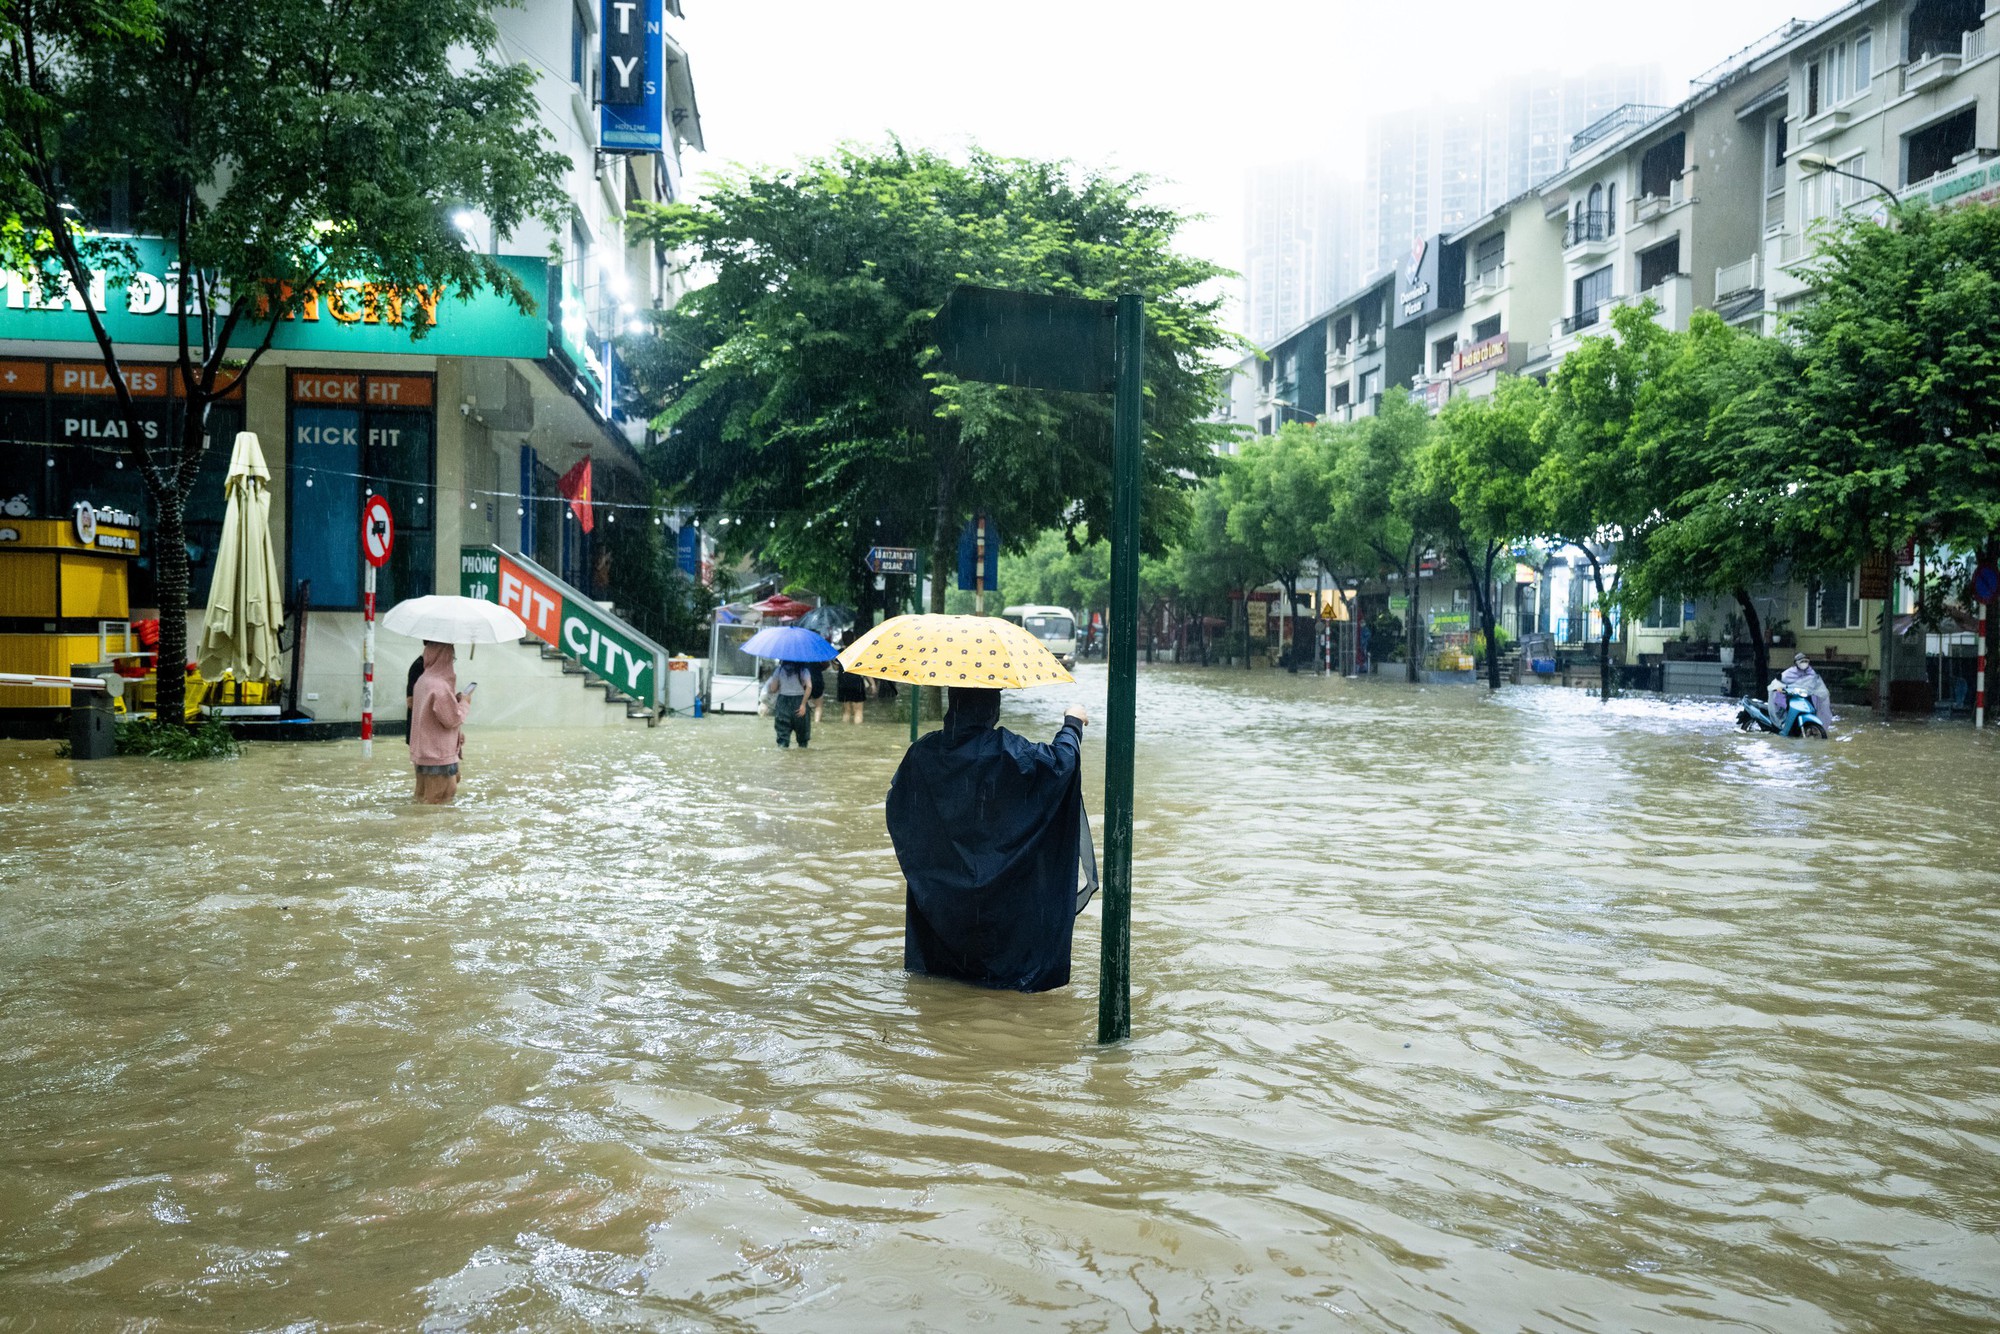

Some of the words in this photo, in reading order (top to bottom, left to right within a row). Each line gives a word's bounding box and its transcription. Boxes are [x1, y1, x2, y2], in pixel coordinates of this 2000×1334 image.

[1400, 282, 1428, 304] Domino's
[1405, 301, 1422, 317] Pizza
[298, 379, 359, 398] KICK
[368, 383, 400, 400] FIT
[64, 418, 158, 439] PILATS
[297, 426, 358, 446] KICK
[368, 429, 400, 447] FIT
[461, 552, 497, 574] PHÒNG
[501, 571, 555, 631] FIT
[563, 616, 647, 689] CITY
